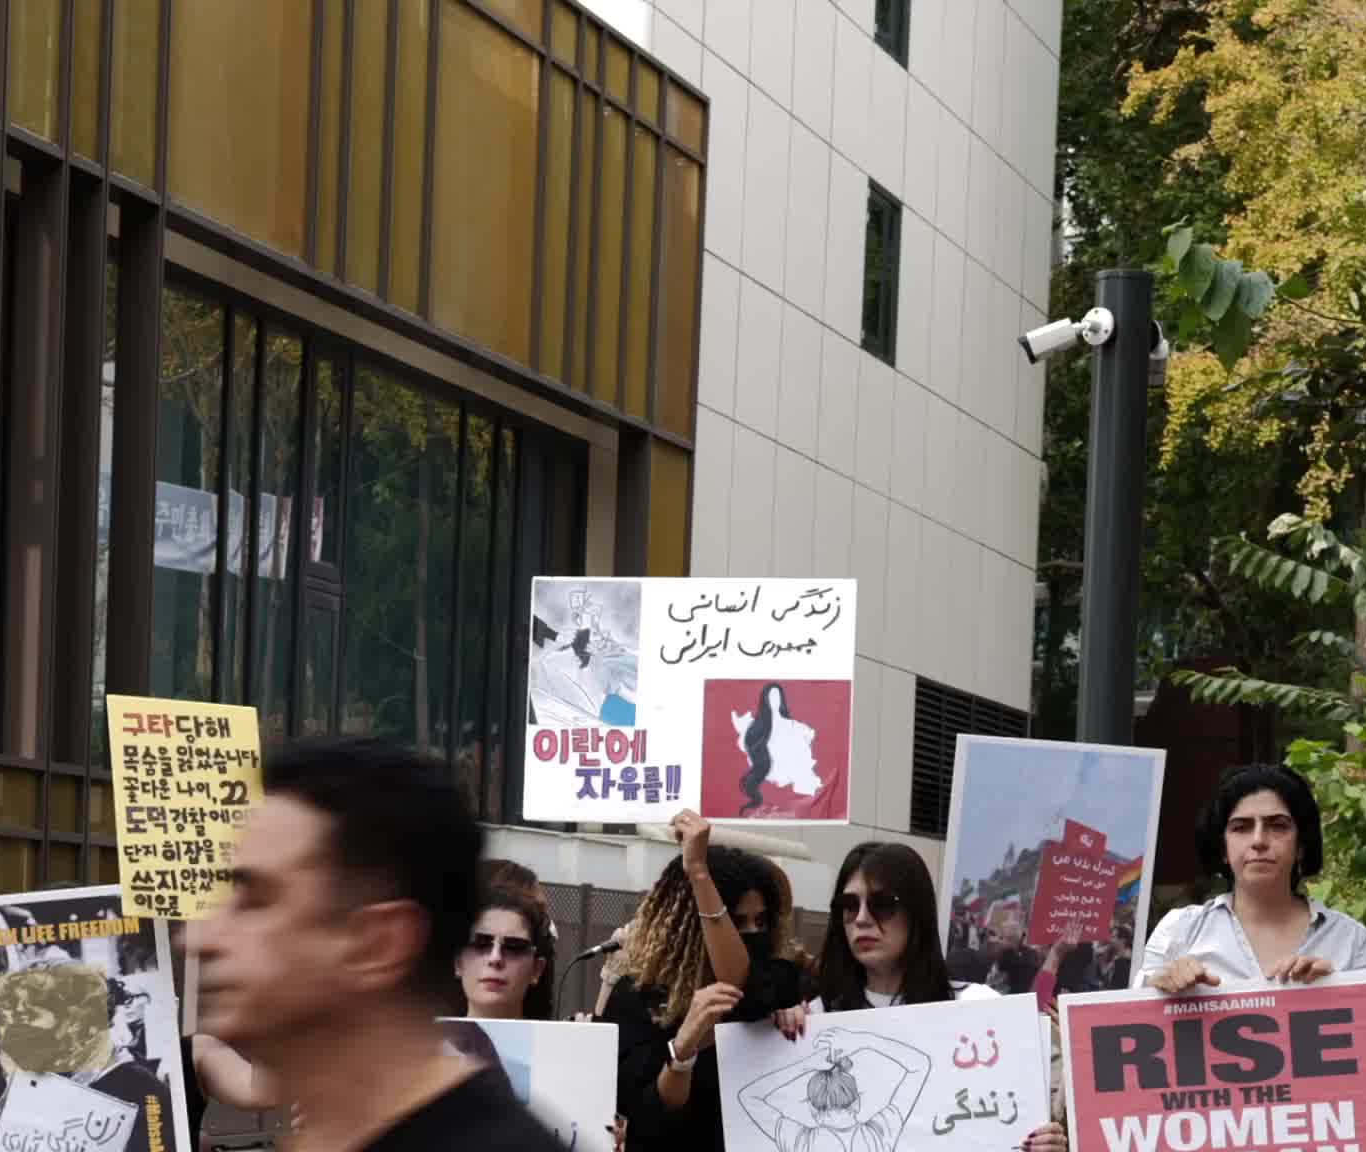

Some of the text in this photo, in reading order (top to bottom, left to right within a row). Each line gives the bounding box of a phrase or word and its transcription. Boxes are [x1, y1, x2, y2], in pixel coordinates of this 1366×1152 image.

[668, 585, 842, 631] زندگی انسانی
[660, 624, 730, 664] ایرانی
[123, 745, 173, 776] 목숨을
[533, 728, 647, 767] 이란에
[219, 780, 249, 806] 22
[575, 765, 682, 803] 자유를!!
[123, 844, 157, 863] 단지
[162, 839, 214, 864] 히잡을
[133, 894, 182, 917] 이유로
[22, 922, 56, 945] LIFE
[1163, 997, 1276, 1015] #MAHSAAMINI
[953, 1029, 1000, 1068] زن
[1091, 1008, 1358, 1092] RISE
[932, 1088, 1019, 1135] زندگی
[1161, 1084, 1292, 1110] WITH THE
[85, 1111, 125, 1146] زن
